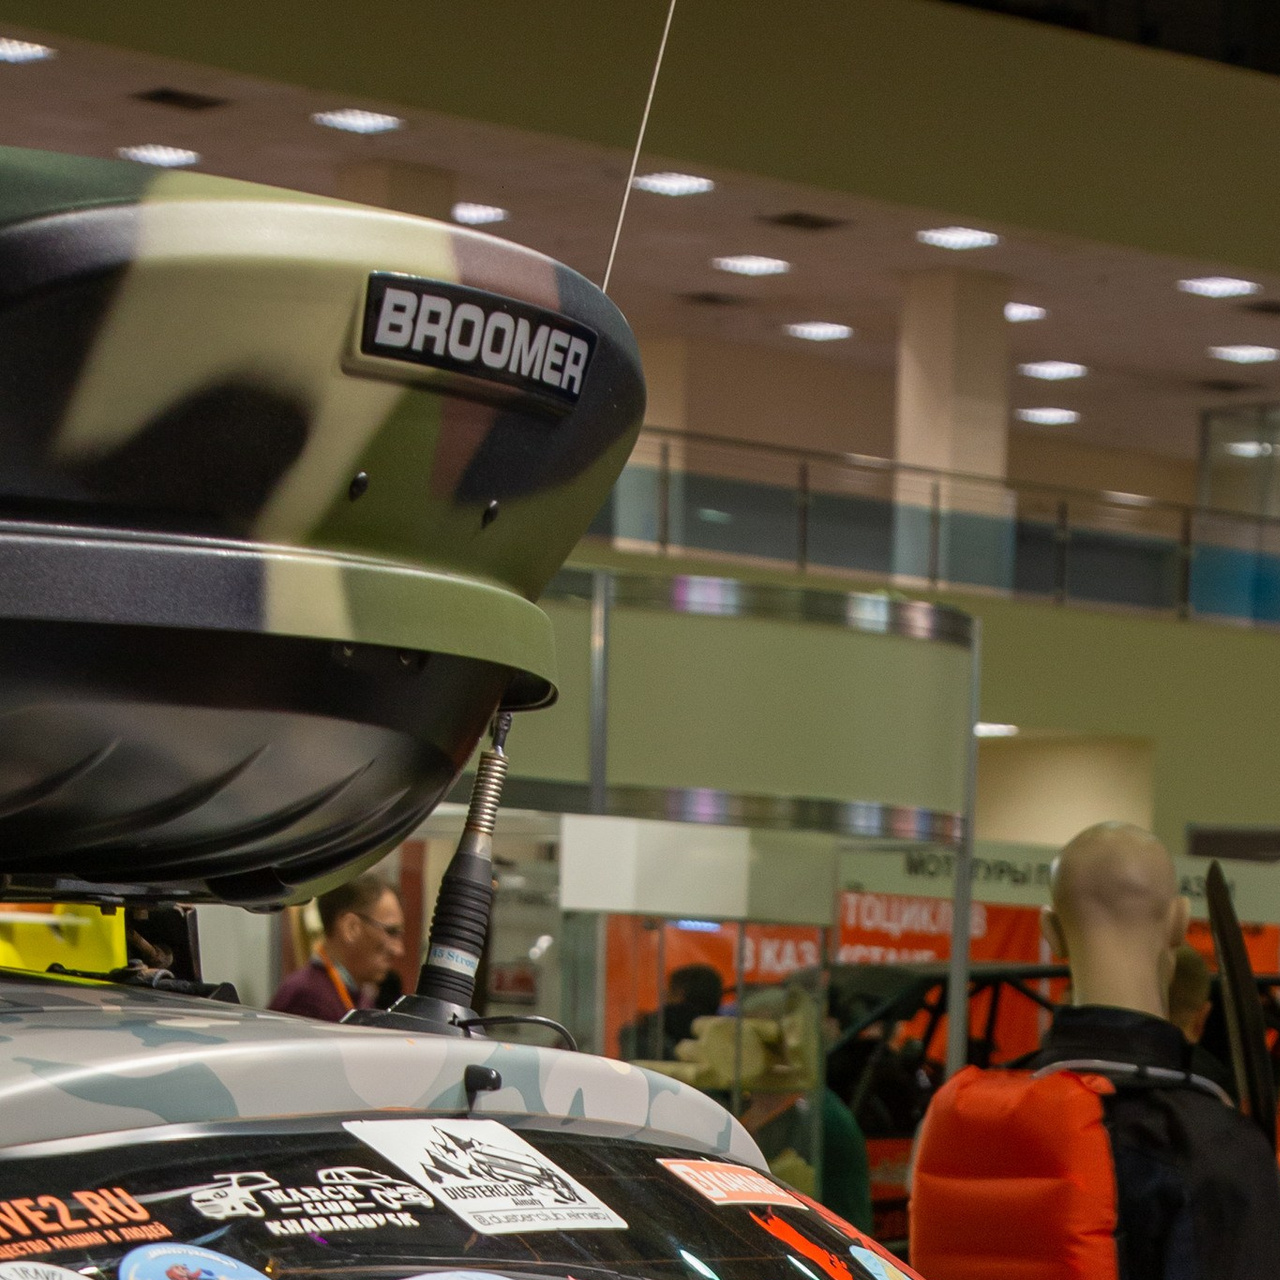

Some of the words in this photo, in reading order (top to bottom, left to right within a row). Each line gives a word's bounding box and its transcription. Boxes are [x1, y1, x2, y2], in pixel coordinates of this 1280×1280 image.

[374, 287, 590, 395] BROOMER
[261, 1185, 364, 1203] MARCH
[442, 1184, 533, 1200] DUSTERCLUB
[511, 1198, 544, 1208] Almaty
[265, 1212, 420, 1236] KHABAROVSK
